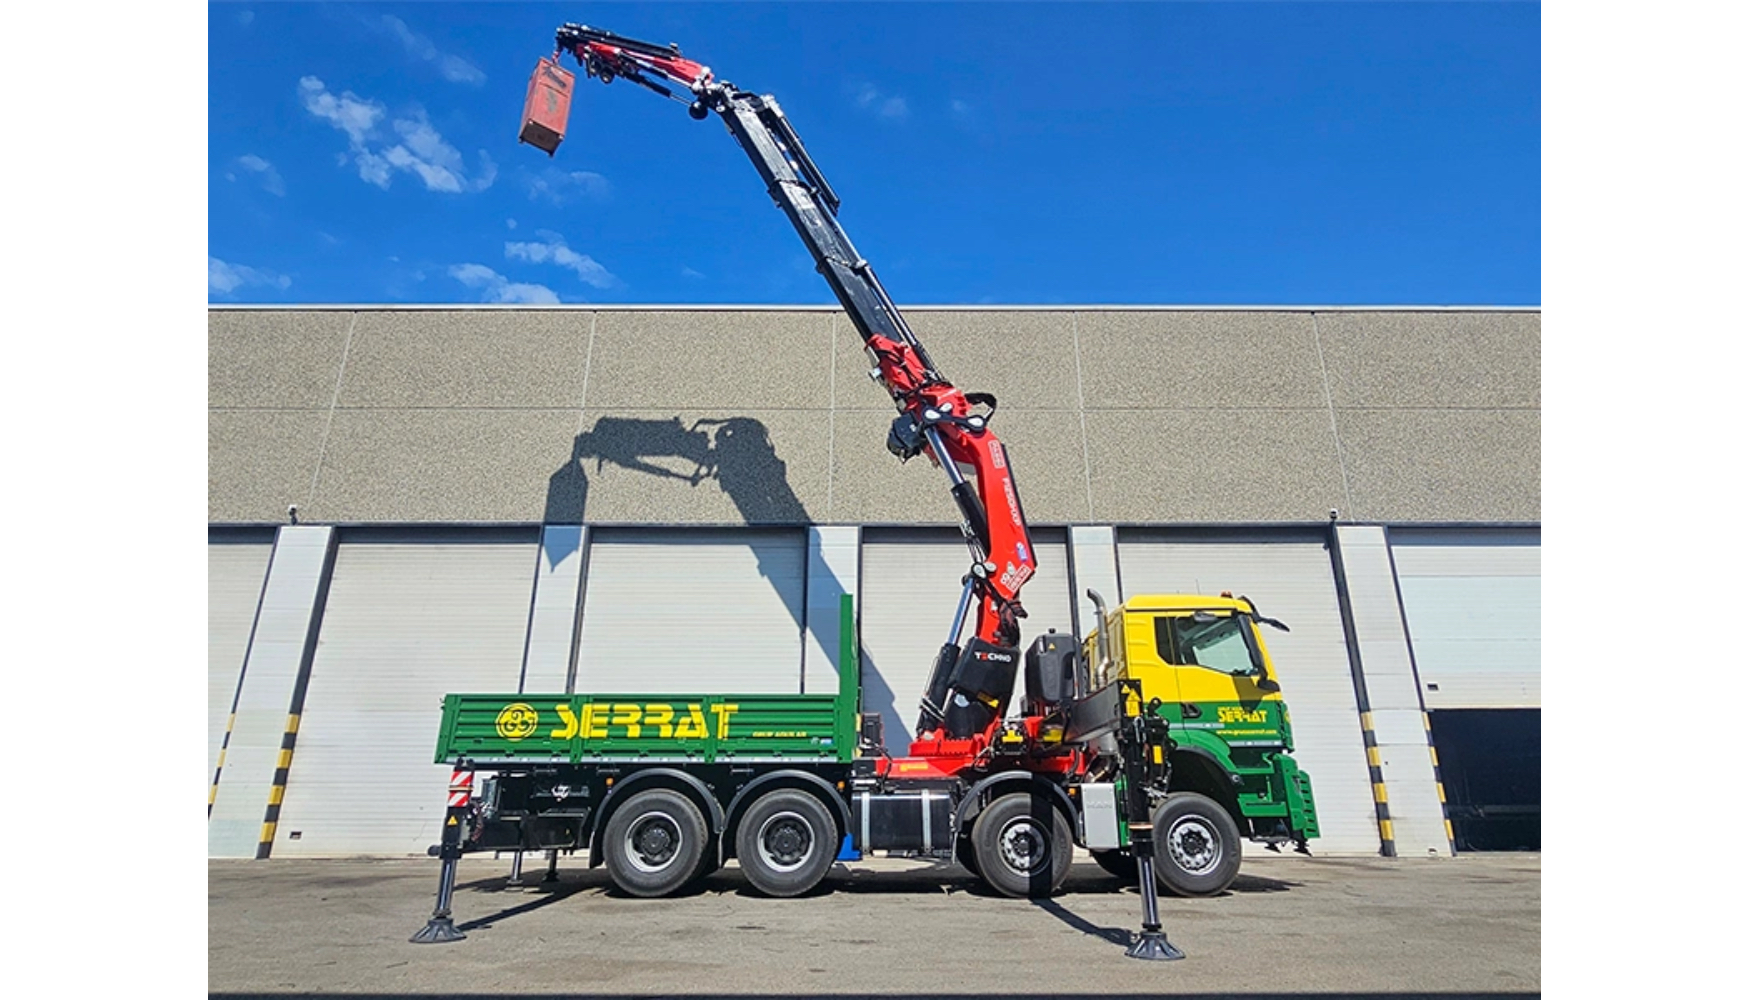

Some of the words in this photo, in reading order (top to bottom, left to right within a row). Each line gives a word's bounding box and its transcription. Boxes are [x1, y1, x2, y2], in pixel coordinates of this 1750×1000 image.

[974, 651, 1012, 663] TECHNO
[551, 704, 739, 740] SERRAT
[1217, 710, 1268, 723] SERRAT
